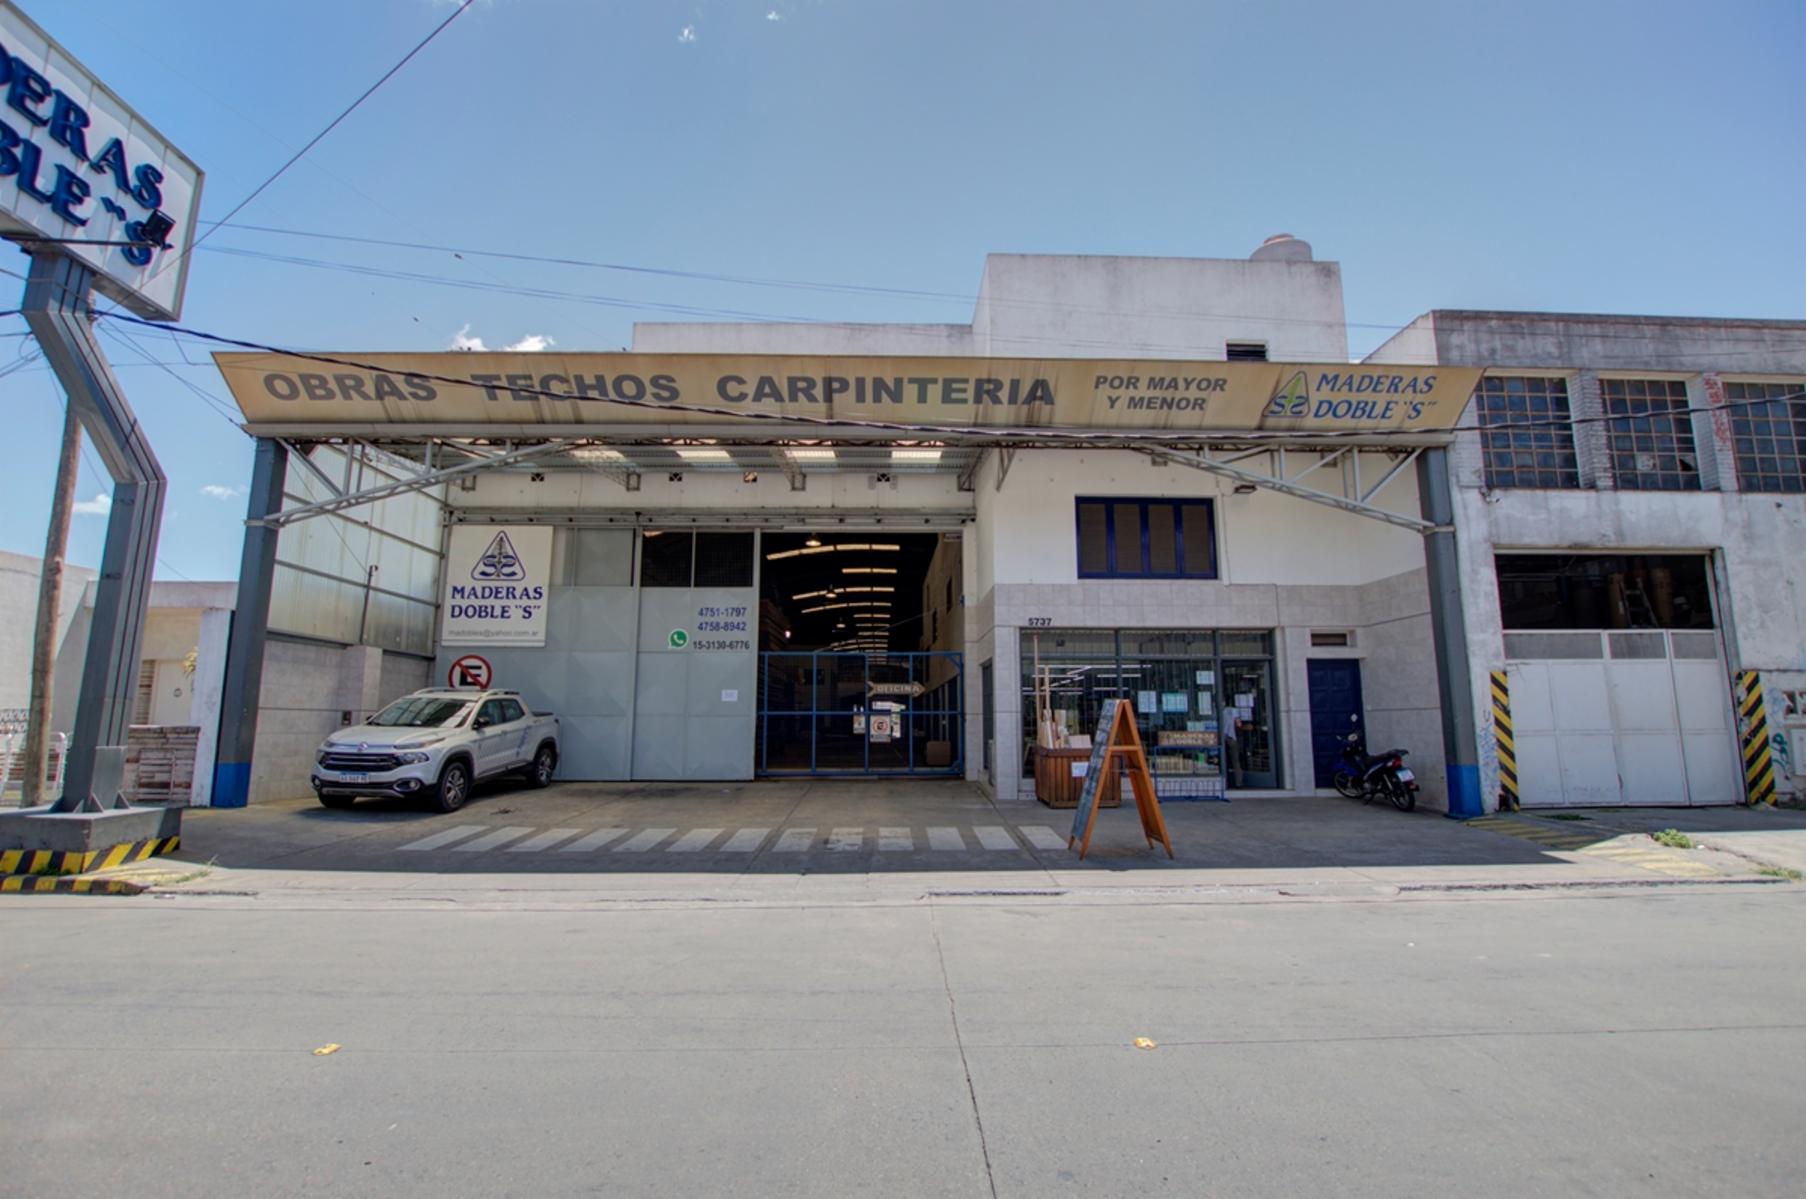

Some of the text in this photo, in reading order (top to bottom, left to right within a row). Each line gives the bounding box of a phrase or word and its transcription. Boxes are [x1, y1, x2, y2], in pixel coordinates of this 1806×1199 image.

[263, 373, 1055, 405] OBRAS TECHOS CARPINTERIA
[1094, 376, 1227, 392] POR MAYOR
[1315, 373, 1437, 394] MADERAS
[1107, 396, 1206, 411] Y MENOR
[1313, 400, 1398, 419] DOBLE
[451, 586, 544, 600] MADERAS
[450, 604, 511, 619] DOBLE
[698, 607, 747, 617] 4751-1797
[698, 621, 747, 631] 4758-8942
[1028, 617, 1052, 626] 5737
[693, 640, 750, 650] 15-3130-6776
